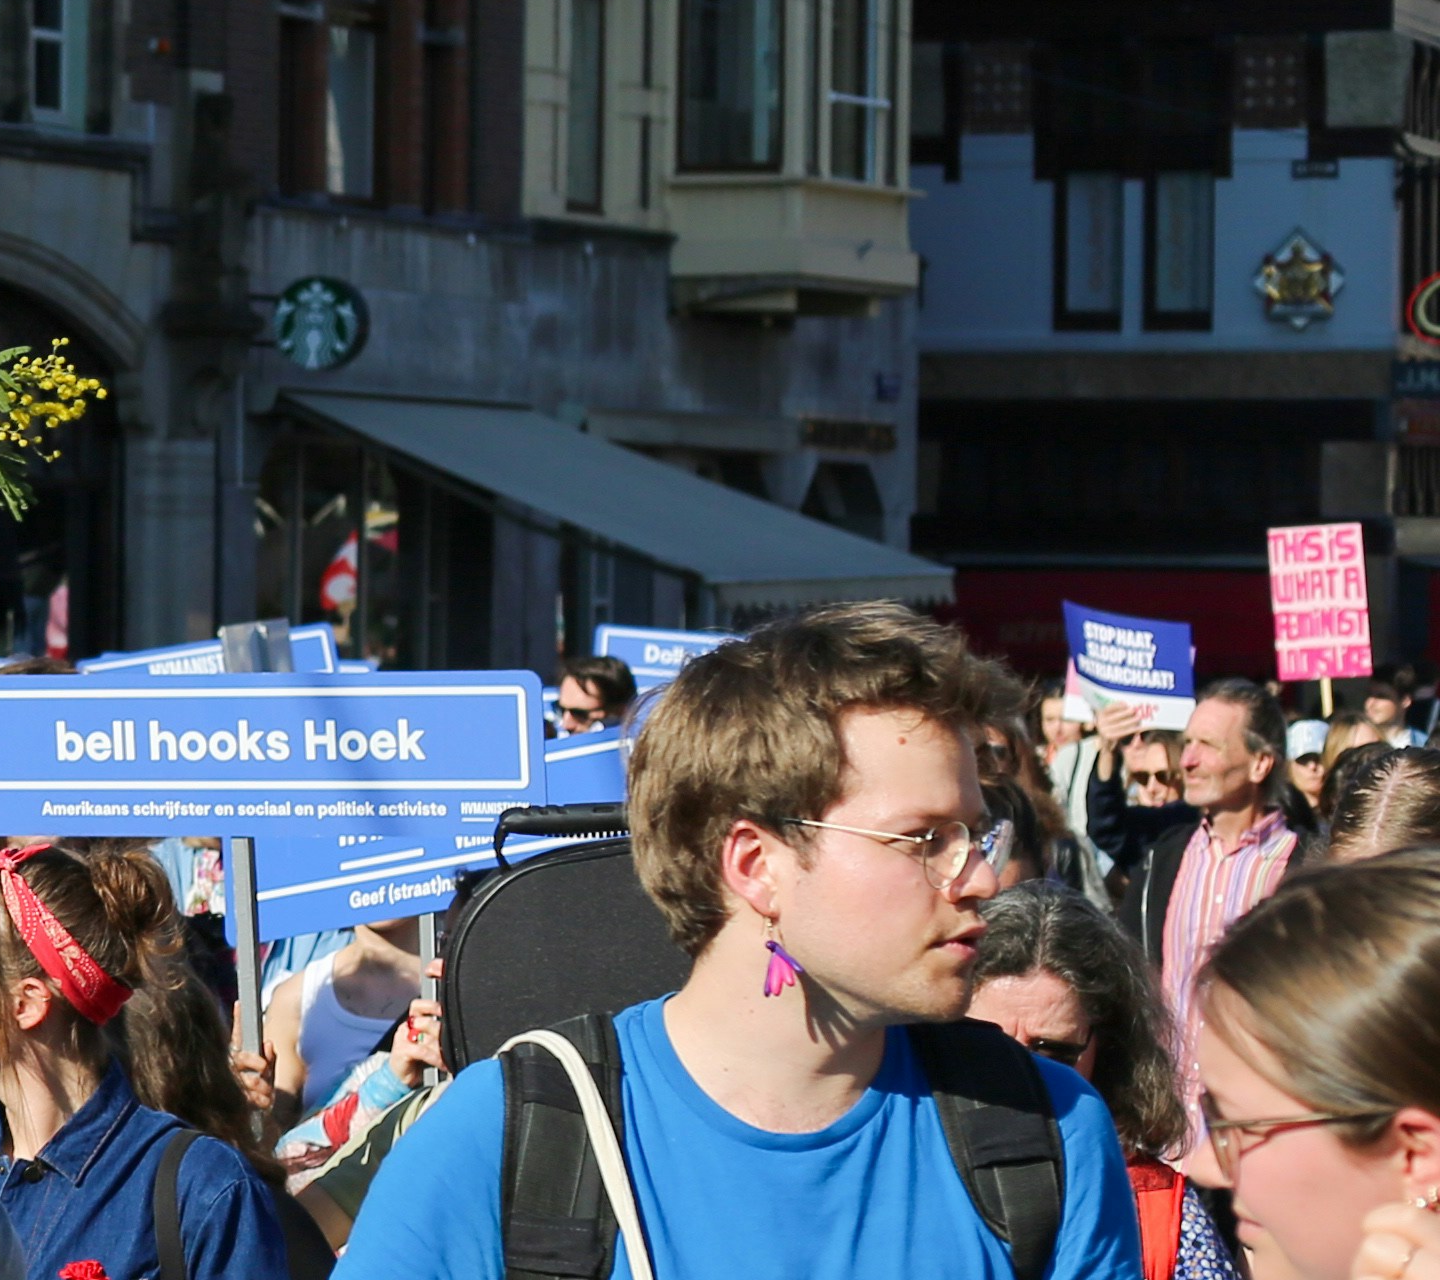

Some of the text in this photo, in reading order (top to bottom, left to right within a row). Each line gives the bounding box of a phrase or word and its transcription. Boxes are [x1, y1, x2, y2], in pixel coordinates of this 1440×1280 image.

[1272, 569, 1339, 603] WHAT
[1083, 620, 1116, 643] STOP
[1086, 640, 1155, 670] SLOOP HET
[55, 718, 427, 762] bell hooks Hoek
[41, 800, 448, 820] Amerikaans schrijfster en sociaal en politiek activiste
[349, 883, 387, 910] Geef
